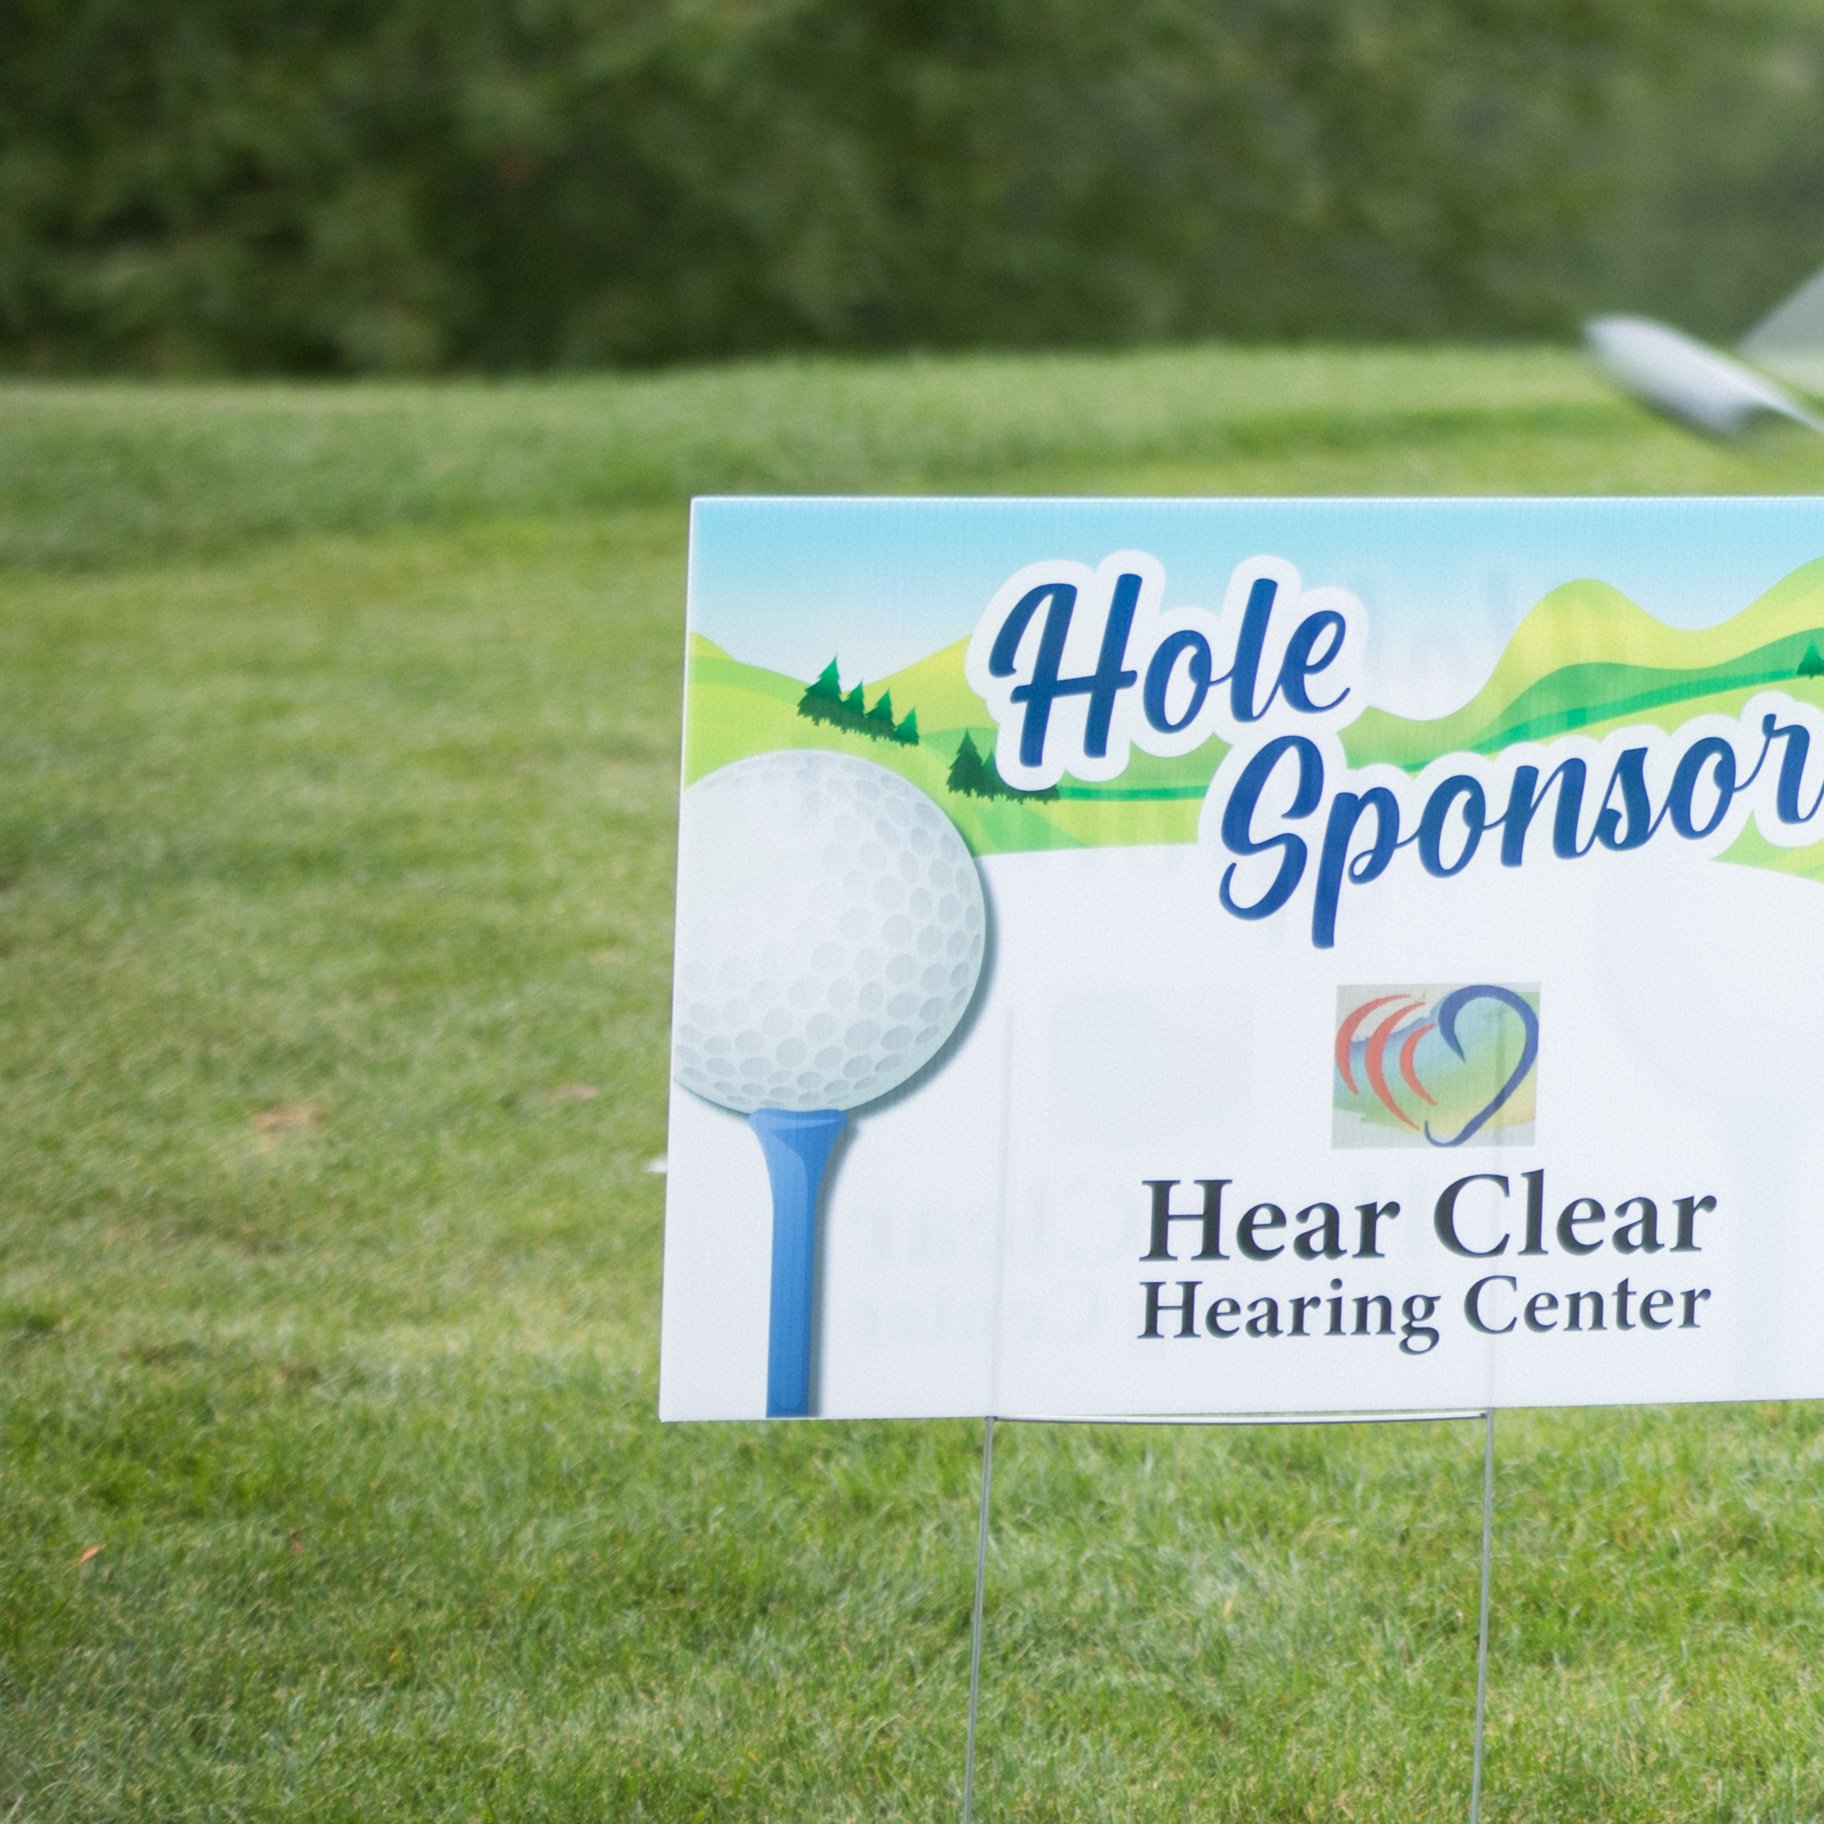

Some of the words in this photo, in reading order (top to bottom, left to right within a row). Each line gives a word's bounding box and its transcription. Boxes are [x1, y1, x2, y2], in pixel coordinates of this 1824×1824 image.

[987, 571, 1352, 769] Hole
[1138, 1175, 1403, 1263] Hear
[1432, 1168, 1719, 1259] Clear
[1136, 1276, 1443, 1356] Hearing
[1462, 1273, 1713, 1335] Center
